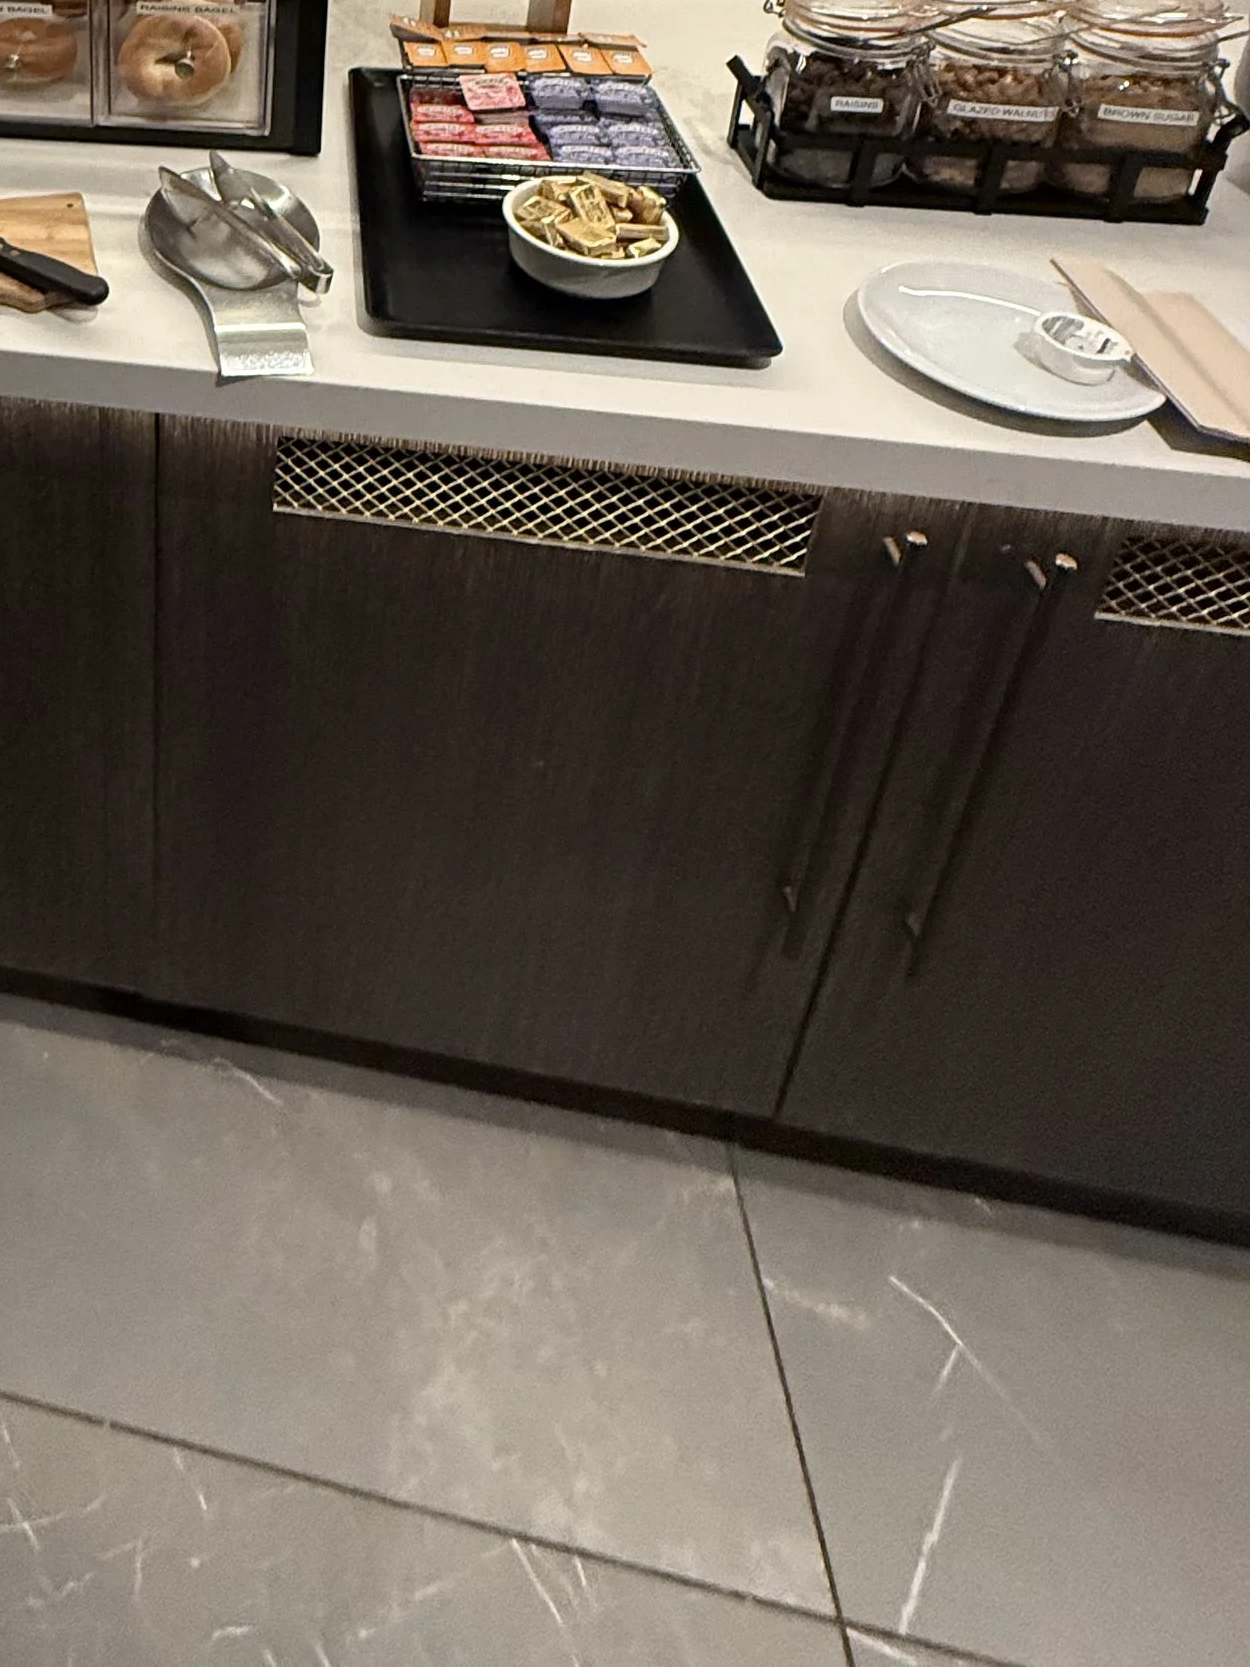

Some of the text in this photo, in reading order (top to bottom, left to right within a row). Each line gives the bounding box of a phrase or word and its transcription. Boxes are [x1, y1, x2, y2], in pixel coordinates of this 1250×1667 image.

[7, 5, 49, 15] BAGEL
[194, 6, 237, 14] BAGEL
[835, 99, 879, 109] RAISINS
[953, 103, 1001, 116] GLAZED
[1103, 107, 1196, 122] BROWN SUGAR
